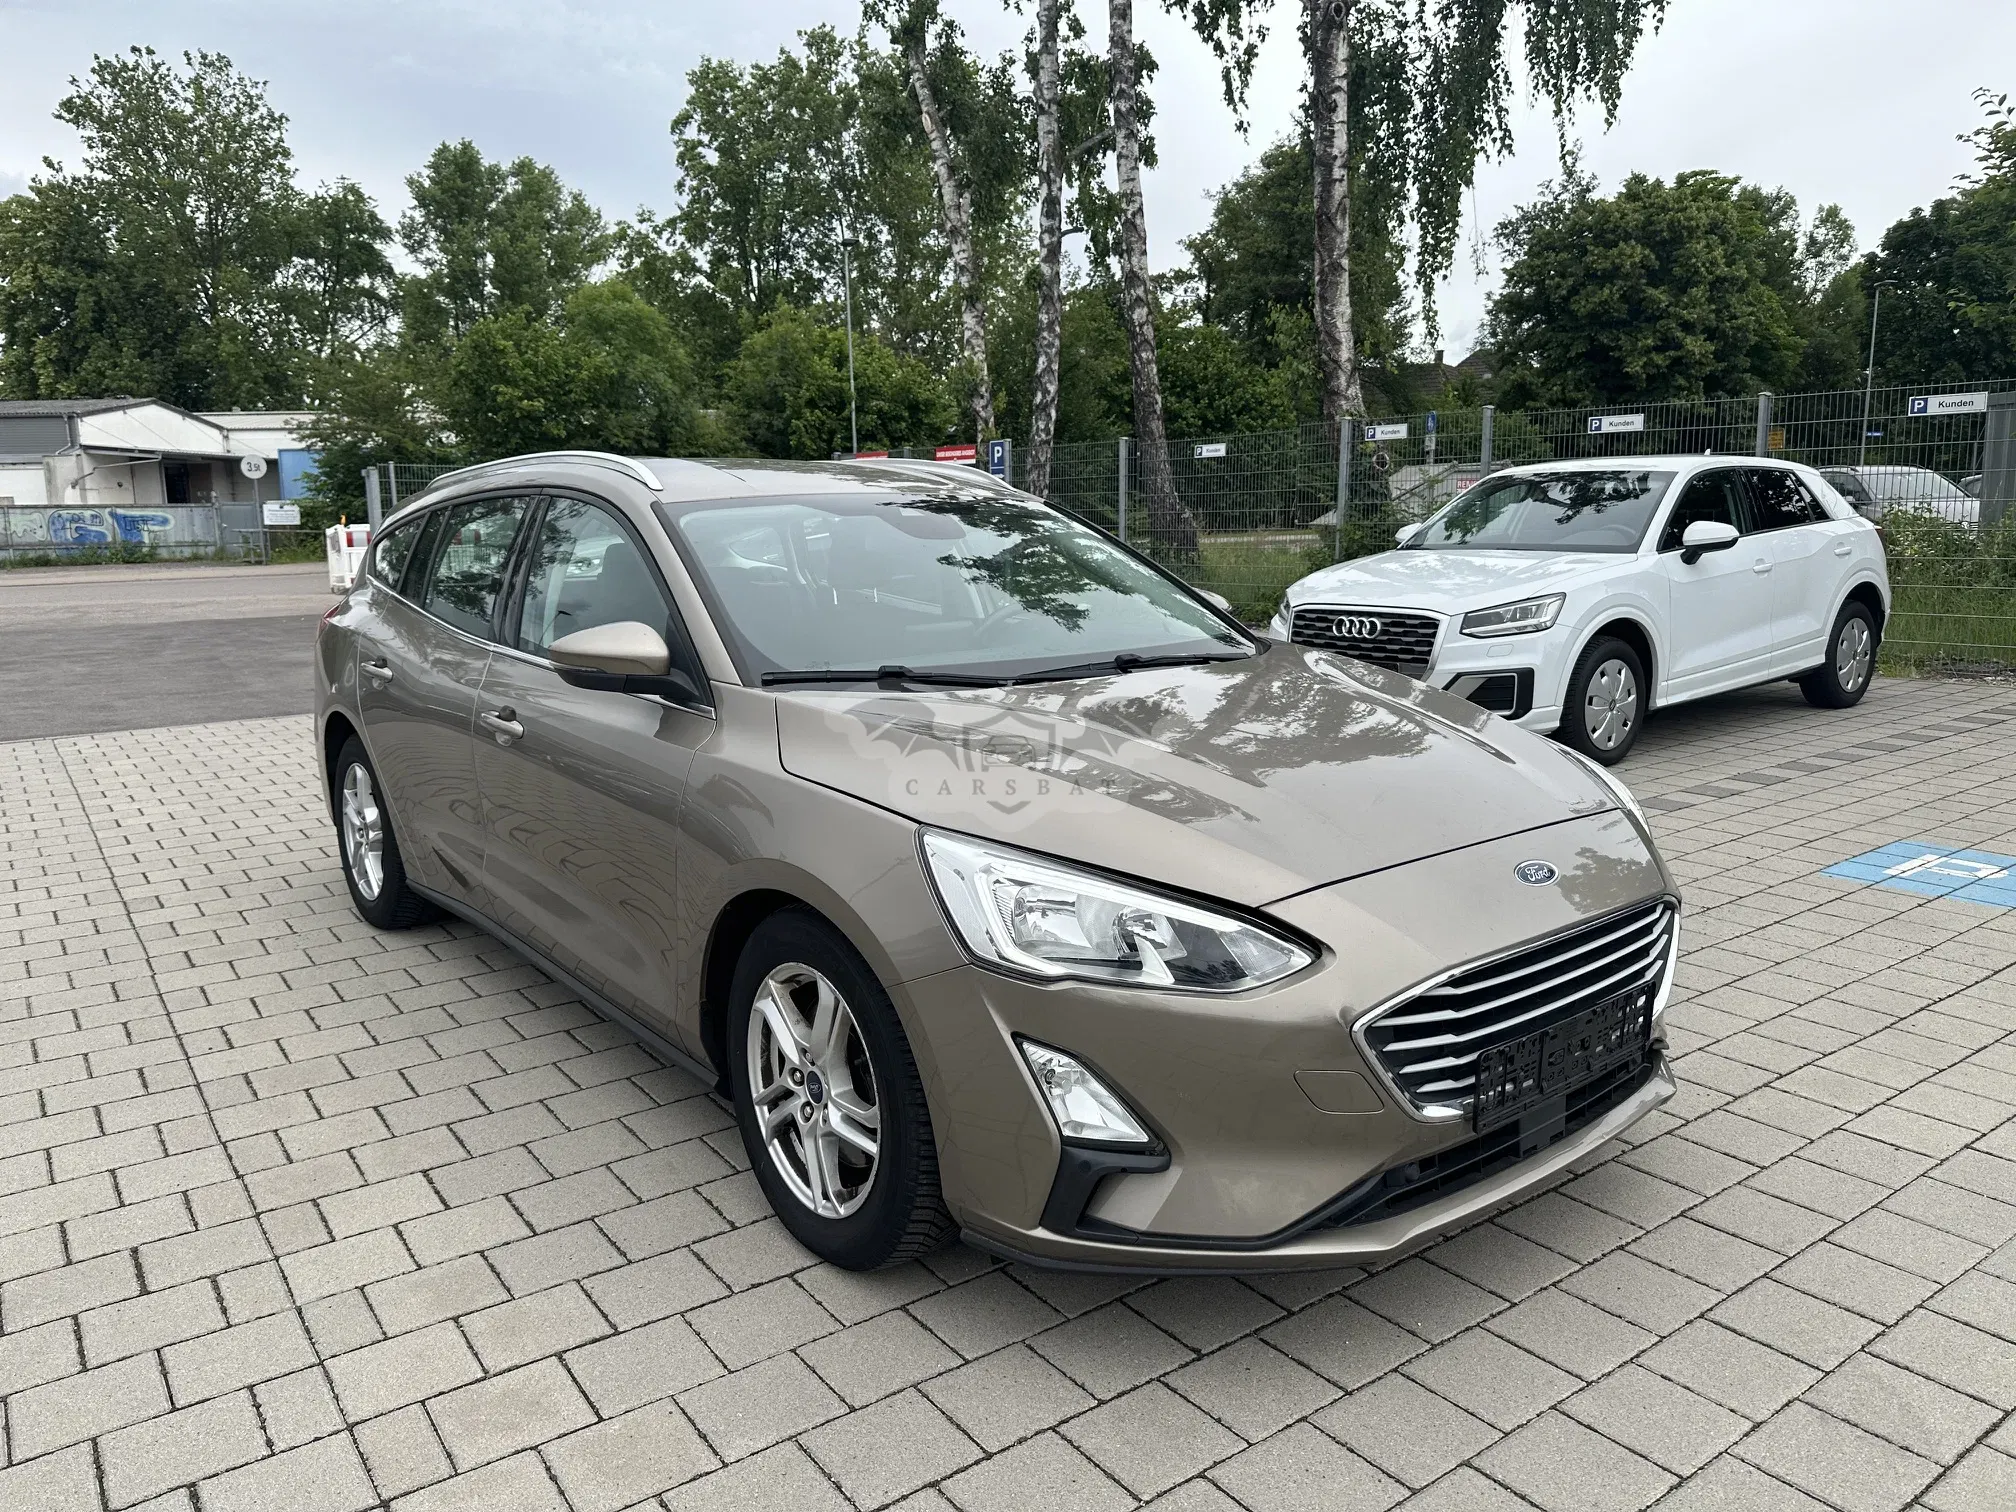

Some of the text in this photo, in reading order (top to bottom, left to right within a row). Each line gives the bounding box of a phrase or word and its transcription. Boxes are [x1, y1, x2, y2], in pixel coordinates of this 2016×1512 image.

[1914, 399, 1974, 412] P Kunden
[1592, 420, 1599, 430] P
[1368, 428, 1374, 437] P
[994, 446, 1002, 463] P
[1524, 865, 1551, 881] Ford
